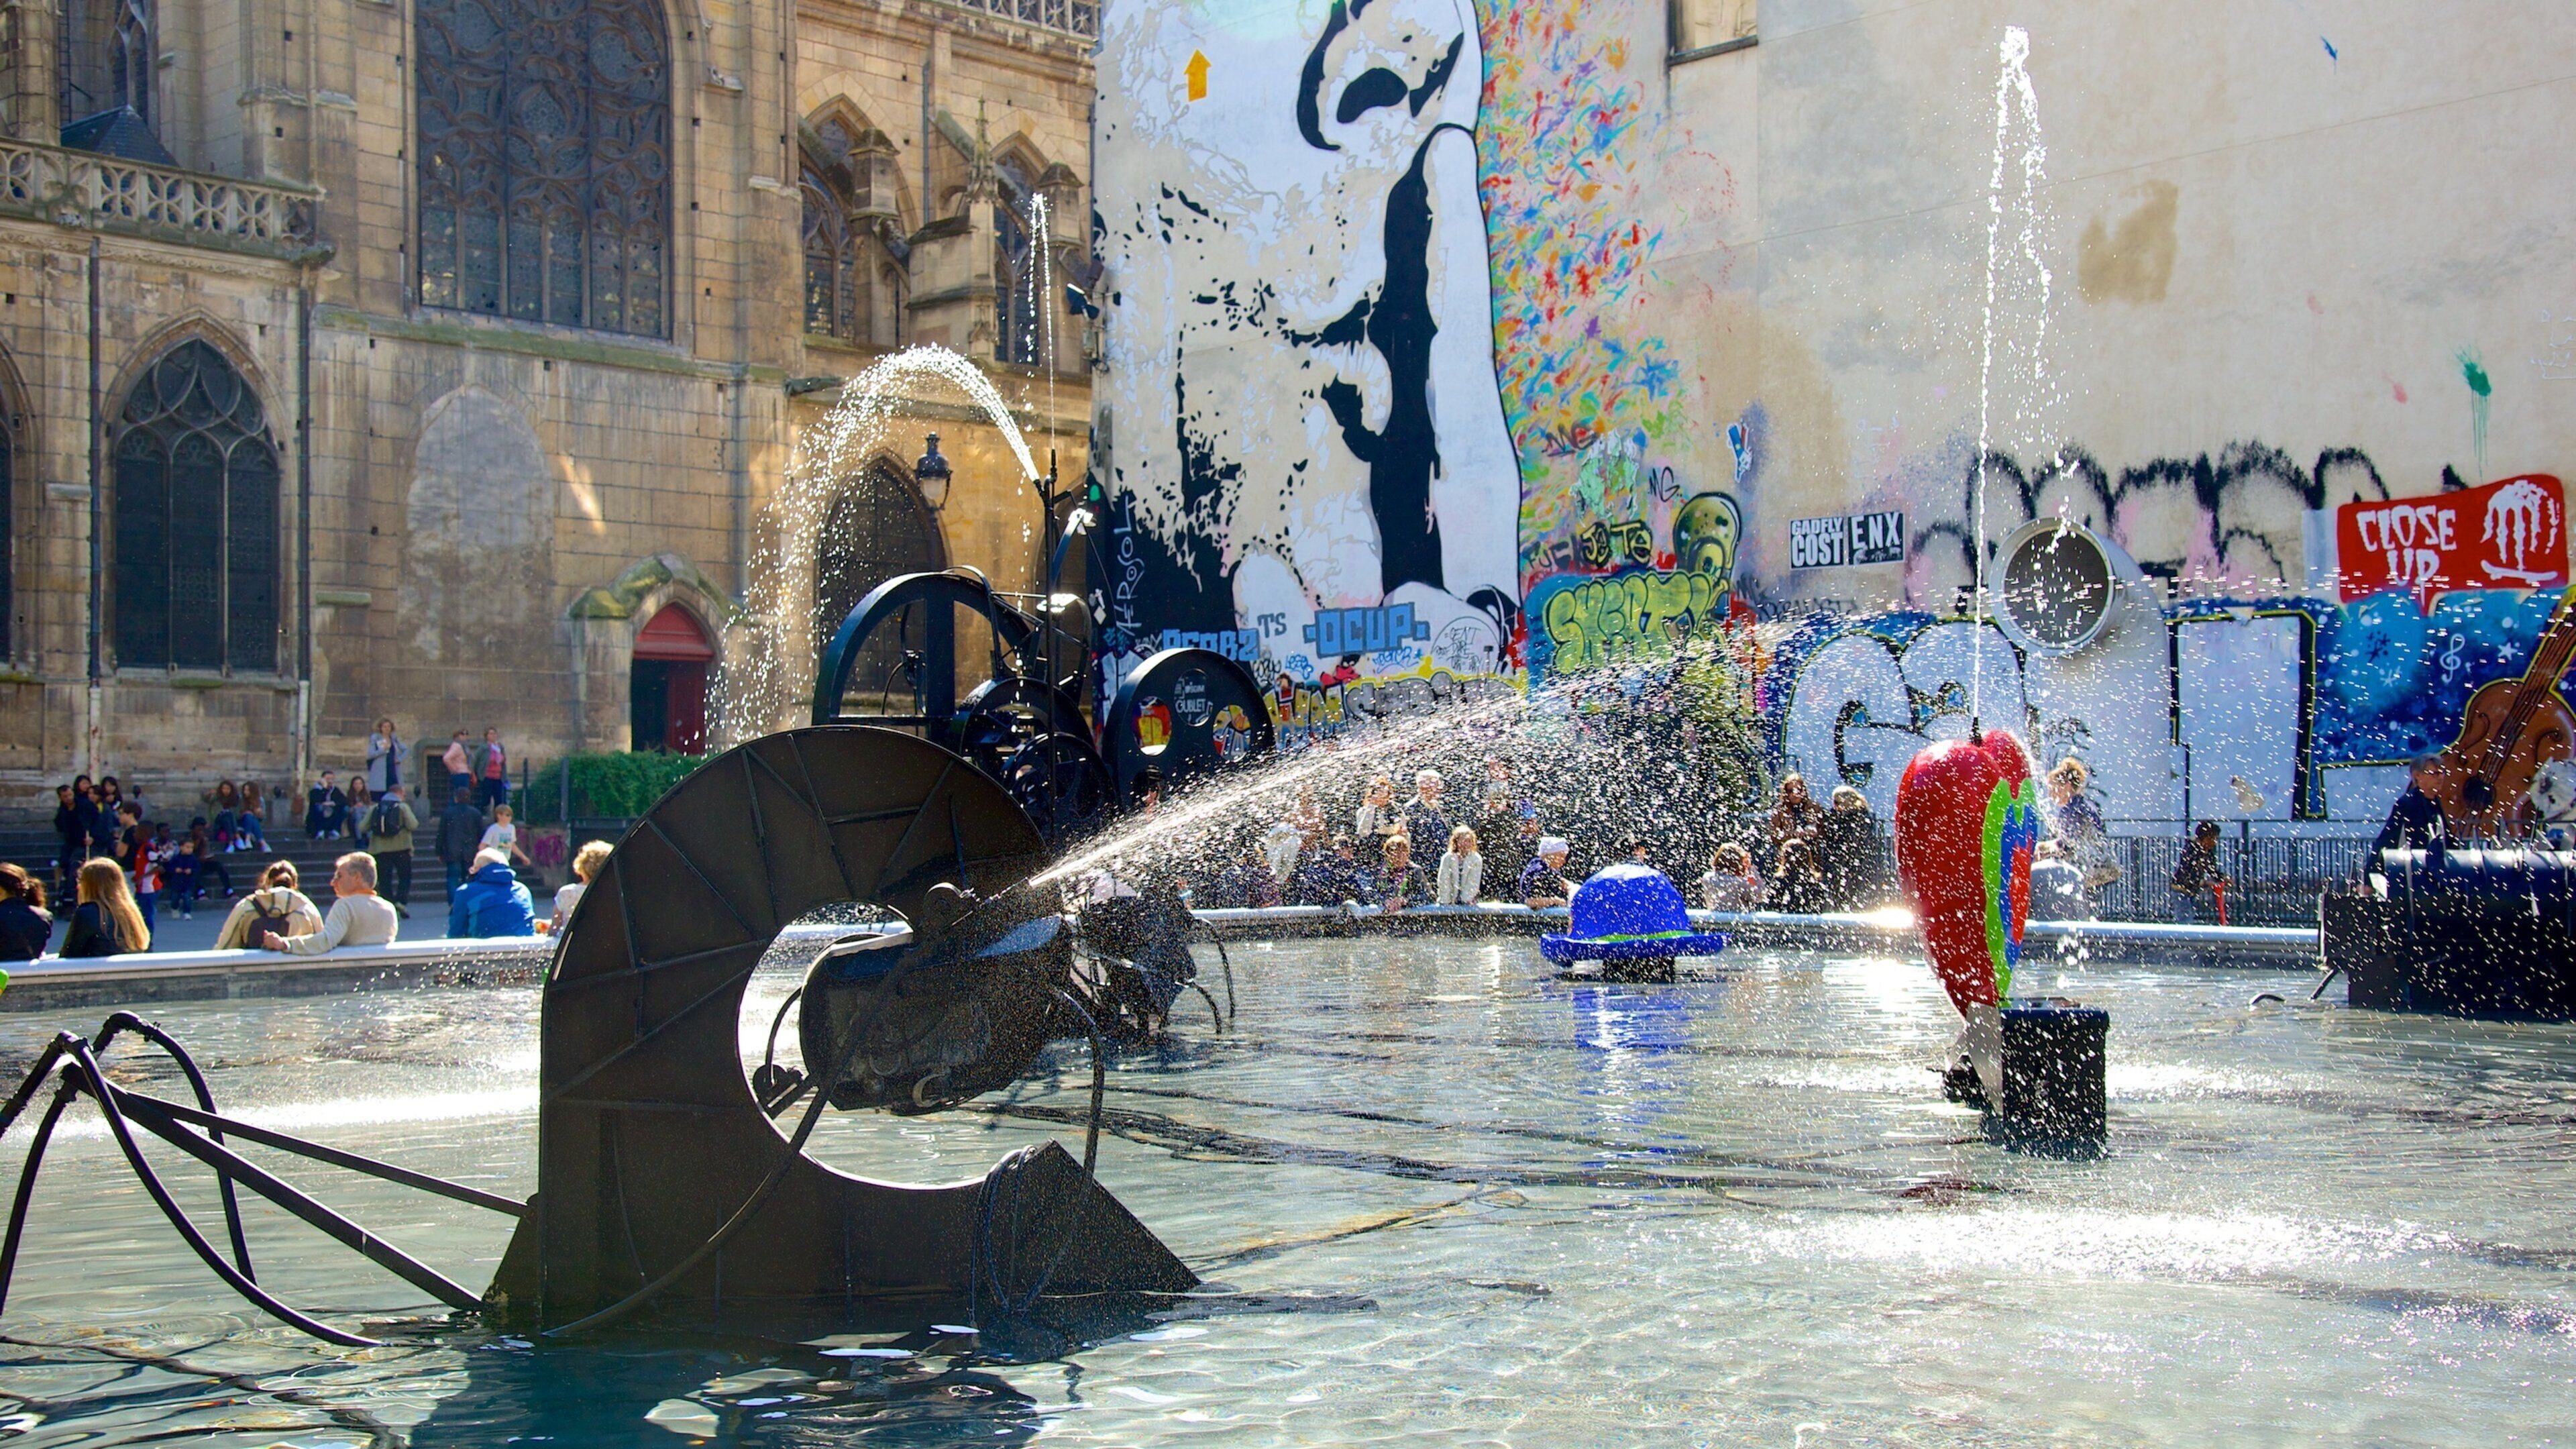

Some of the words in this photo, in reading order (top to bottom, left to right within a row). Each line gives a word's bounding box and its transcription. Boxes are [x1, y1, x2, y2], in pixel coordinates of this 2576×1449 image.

[1790, 517, 1843, 537] GADFLY
[1849, 511, 1901, 550] ENX
[2356, 504, 2457, 552] CLOSE
[1790, 531, 1843, 568] COST
[2385, 546, 2440, 604] UP
